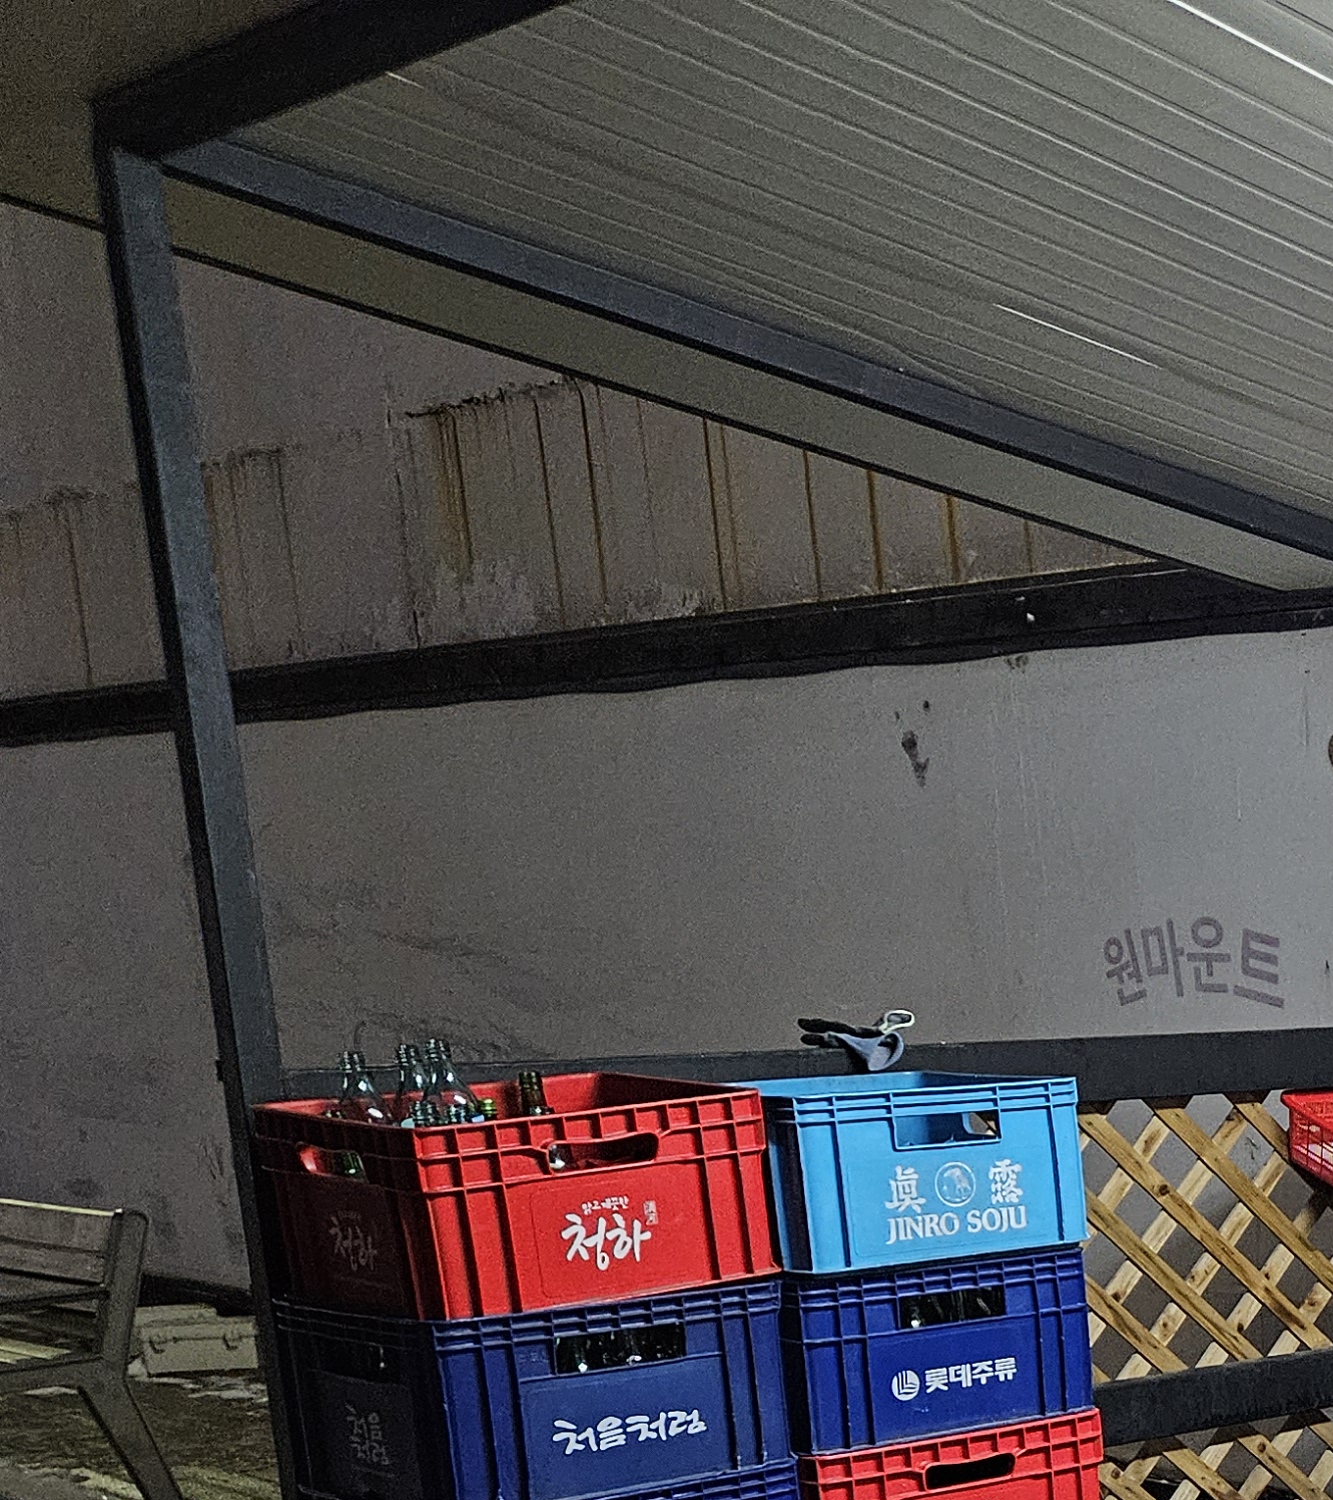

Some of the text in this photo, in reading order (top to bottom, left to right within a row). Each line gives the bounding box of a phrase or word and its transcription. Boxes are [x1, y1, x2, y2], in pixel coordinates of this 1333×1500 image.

[1103, 916, 1286, 1009] 원마운트
[561, 1213, 652, 1271] 청하
[885, 1205, 1028, 1245] JINRO SOJU
[924, 1357, 1017, 1394] 롯데주류
[552, 1409, 708, 1455] 처음처럼
